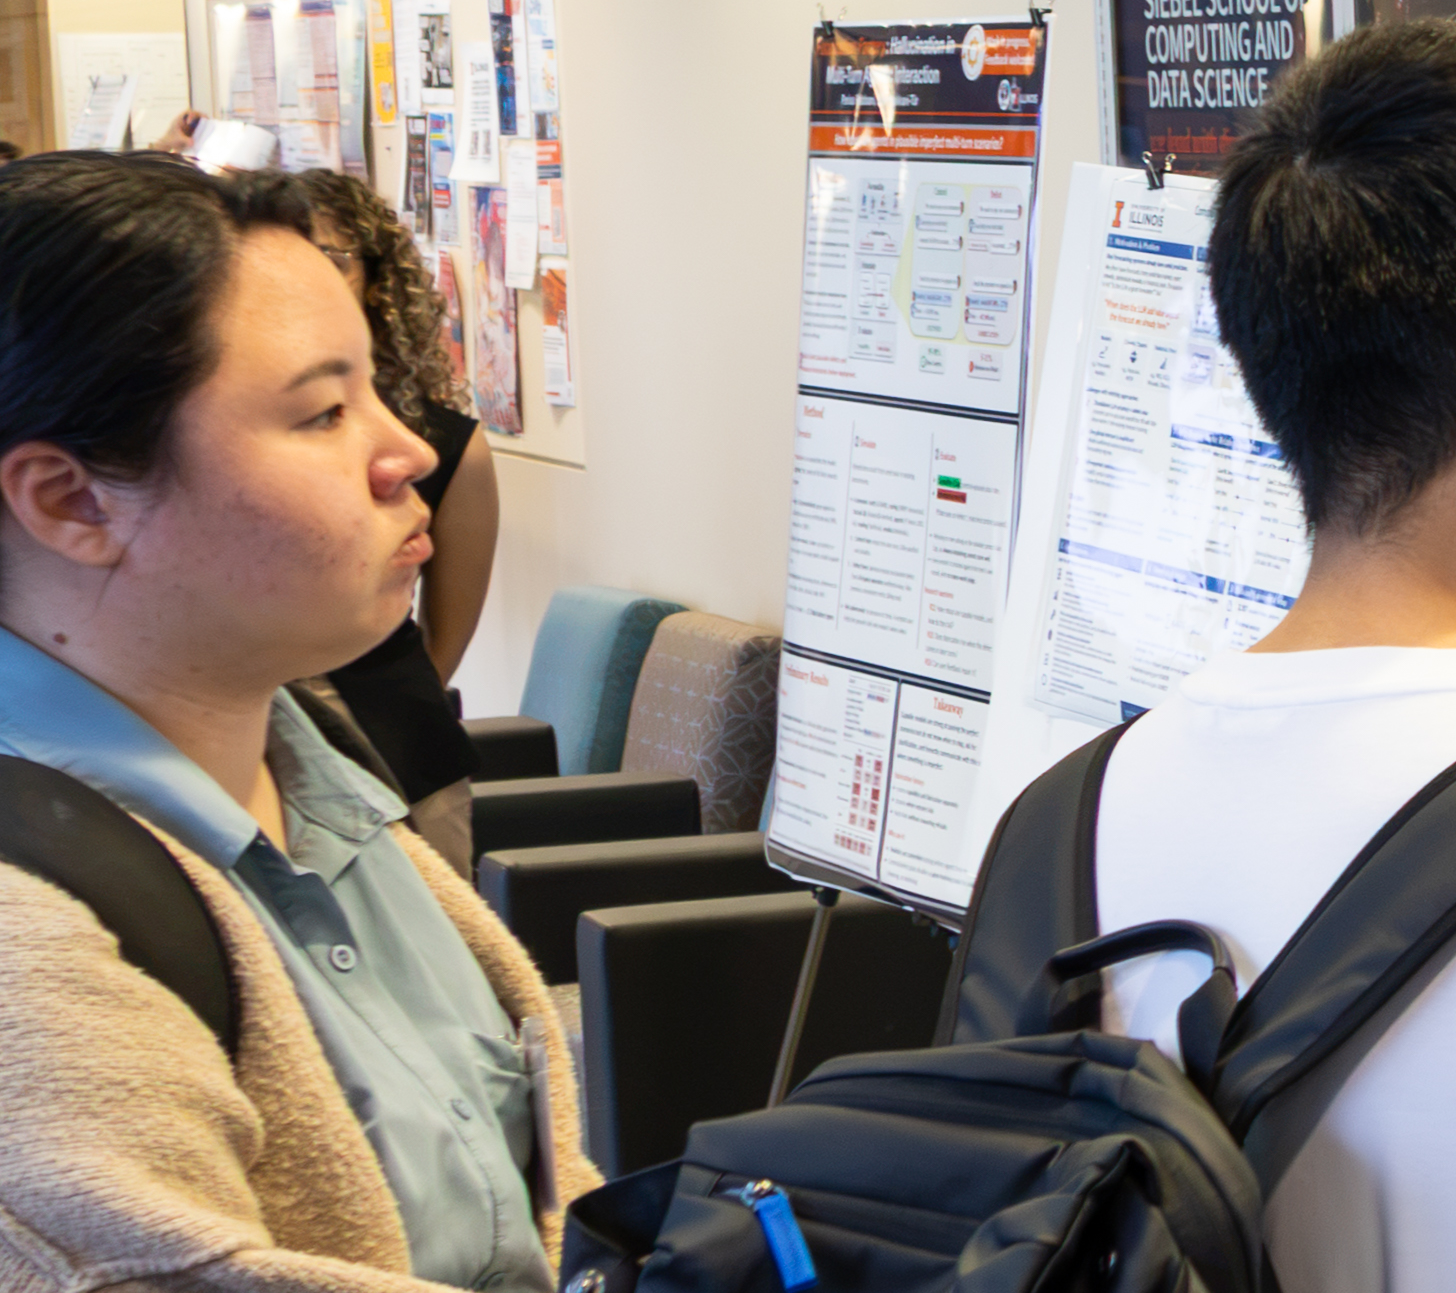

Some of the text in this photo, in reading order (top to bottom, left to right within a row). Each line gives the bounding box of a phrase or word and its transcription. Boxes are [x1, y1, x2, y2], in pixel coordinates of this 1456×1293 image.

[1145, 20, 1294, 64] COMPUTING AND
[1147, 70, 1191, 108] DATA
